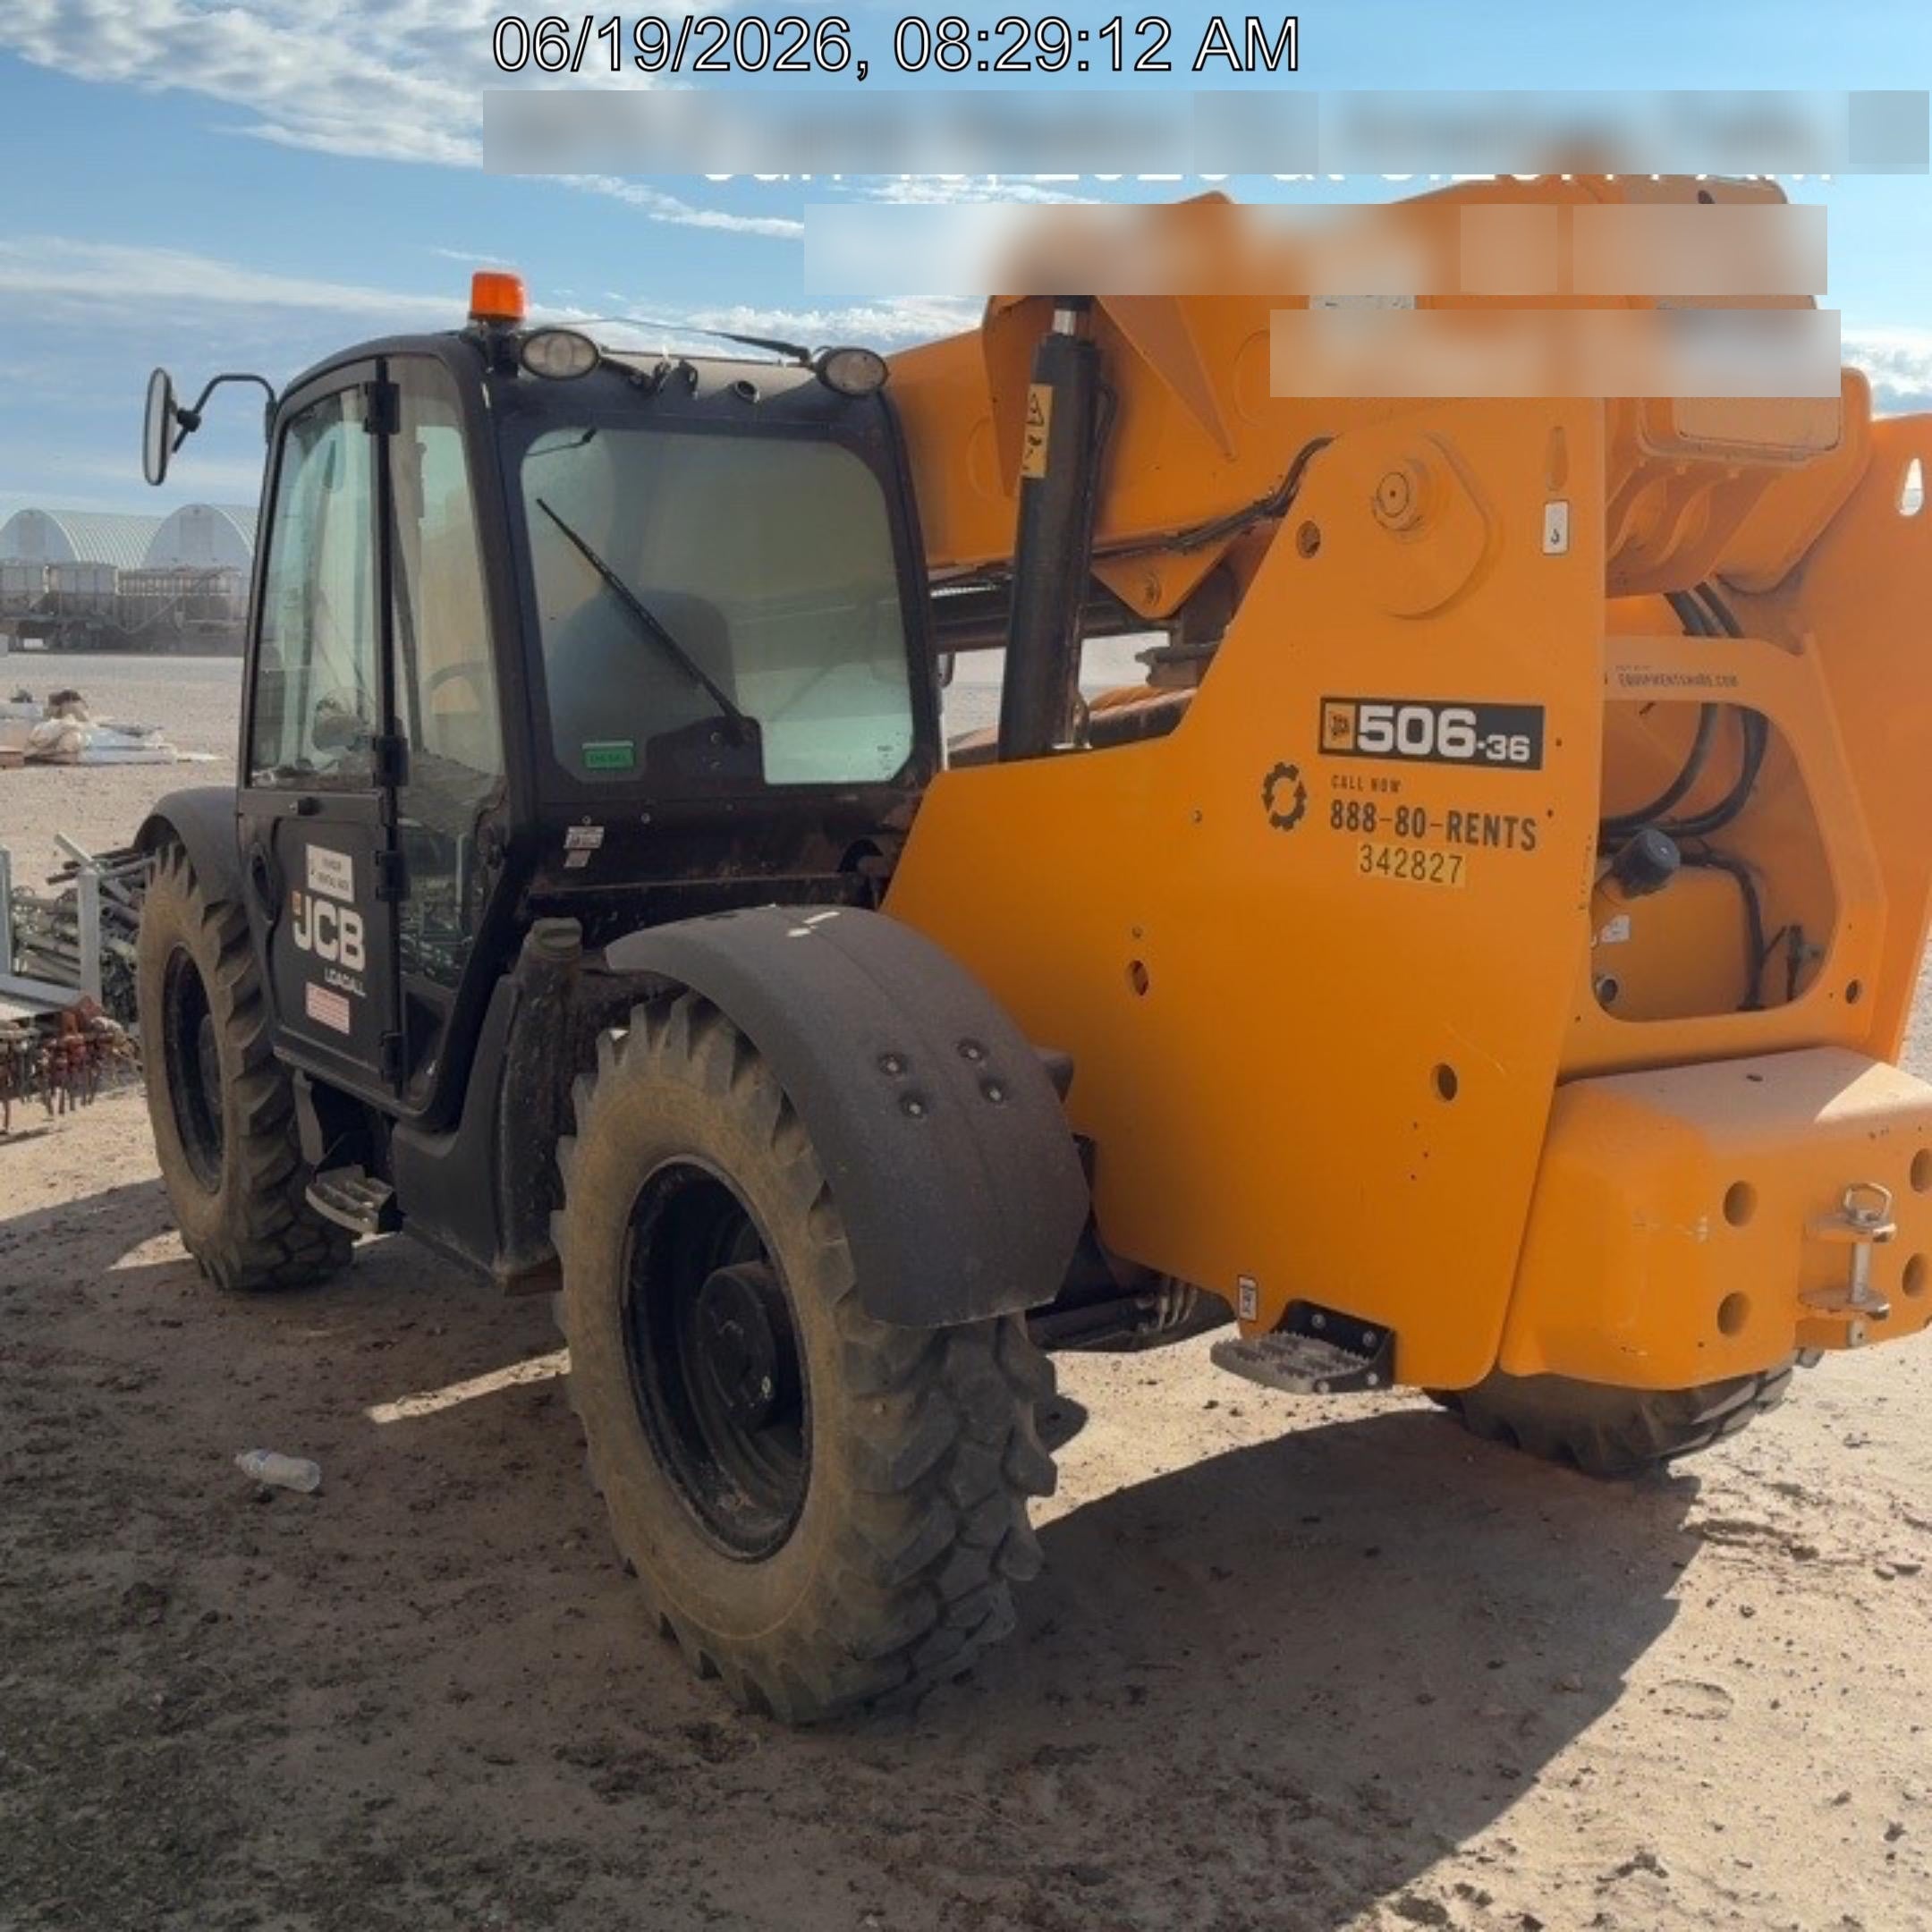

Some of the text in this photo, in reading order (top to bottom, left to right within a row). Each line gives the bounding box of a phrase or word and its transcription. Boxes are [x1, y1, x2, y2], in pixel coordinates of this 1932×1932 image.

[1331, 775, 1402, 793] CALL NOW
[1330, 800, 1538, 851] 888-80-RENTS
[1359, 843, 1464, 884] 342827
[292, 894, 365, 971] JCB
